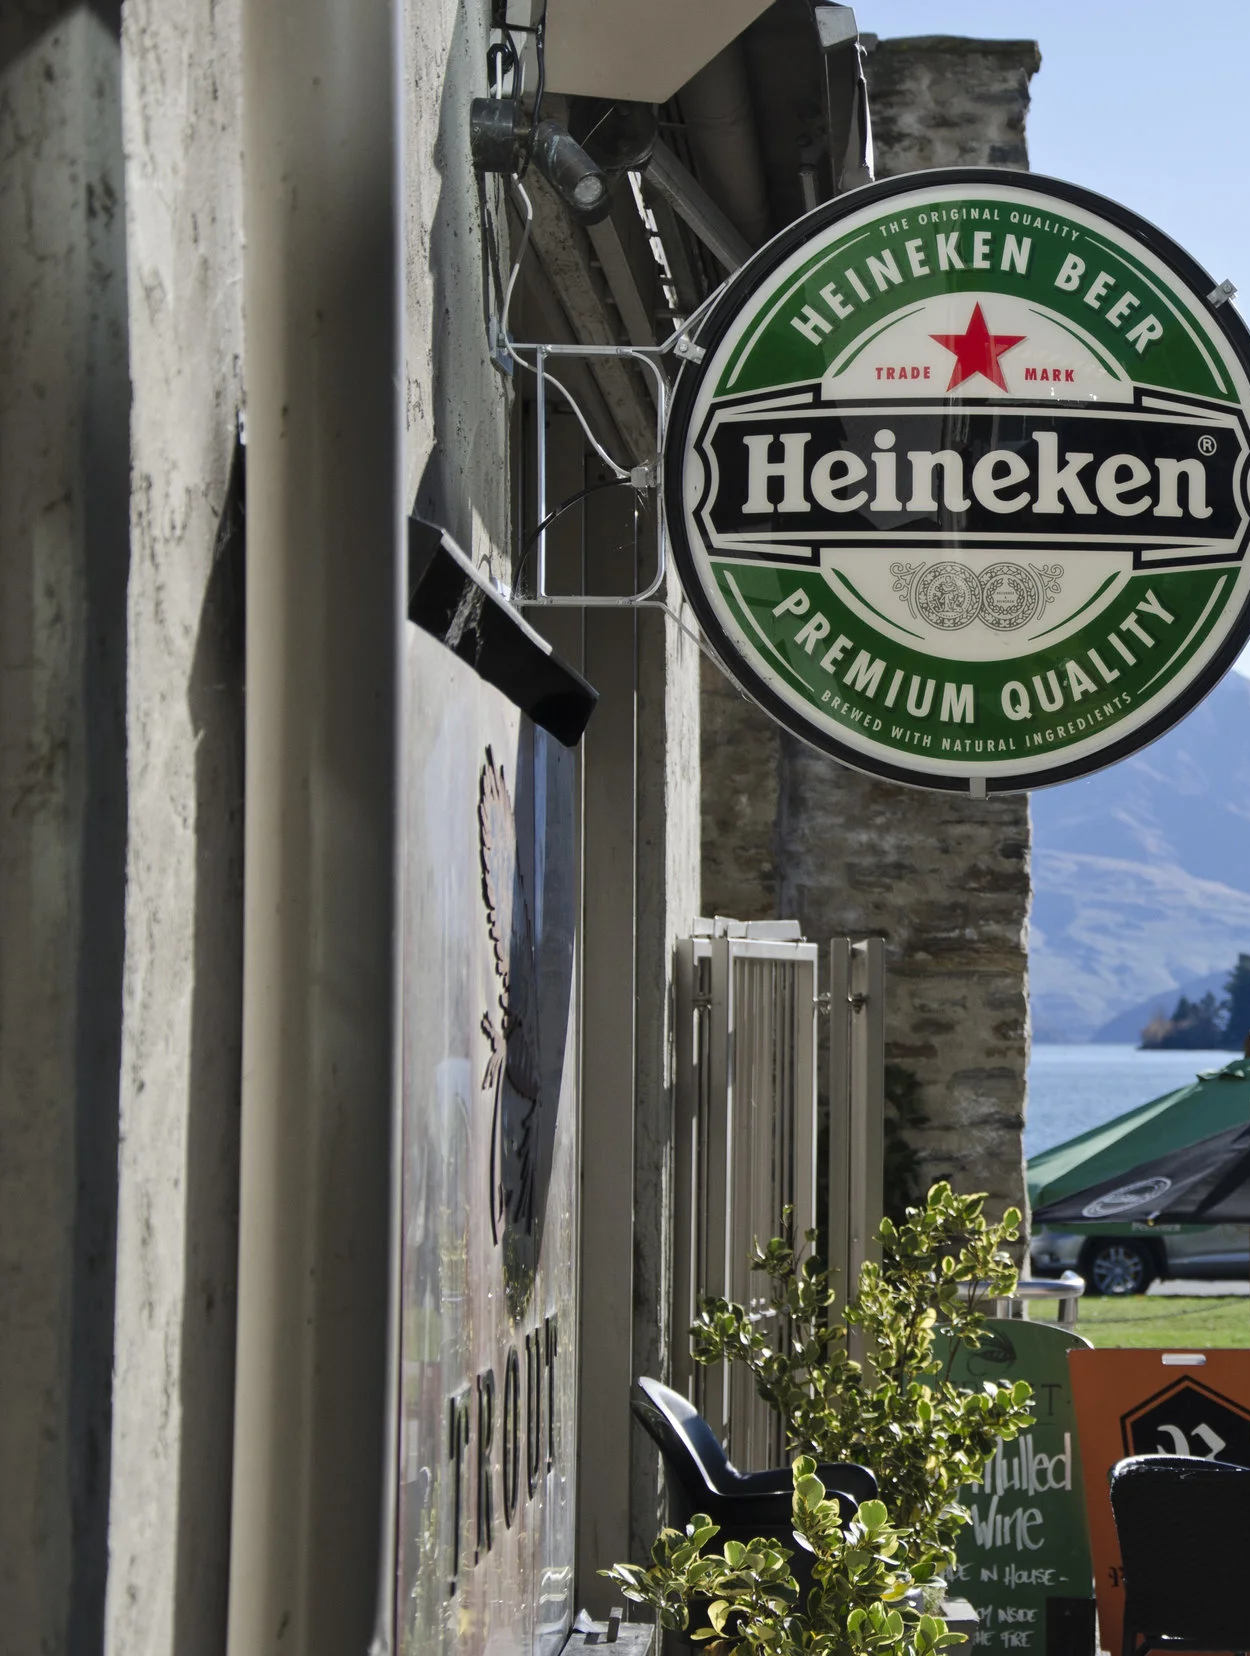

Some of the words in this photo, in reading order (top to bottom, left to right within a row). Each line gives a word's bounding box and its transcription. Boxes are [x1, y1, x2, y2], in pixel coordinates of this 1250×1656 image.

[878, 217, 909, 237] THE
[918, 208, 1000, 225] ORIGINAL
[1010, 211, 1080, 241] QUALITY
[790, 231, 1033, 347] HEINEKEN
[1054, 252, 1164, 355] BEER
[875, 366, 931, 380] TRADE
[1024, 367, 1075, 382] MARK
[771, 587, 975, 724] PREMIUM
[1001, 588, 1175, 721] QUALITY
[821, 689, 883, 731] BREWED
[891, 725, 932, 747] WITH
[941, 738, 1016, 752] NATURAL
[1025, 691, 1132, 747] INGREDIENTS
[970, 1495, 1045, 1551] Wine
[980, 1563, 998, 1583] IN
